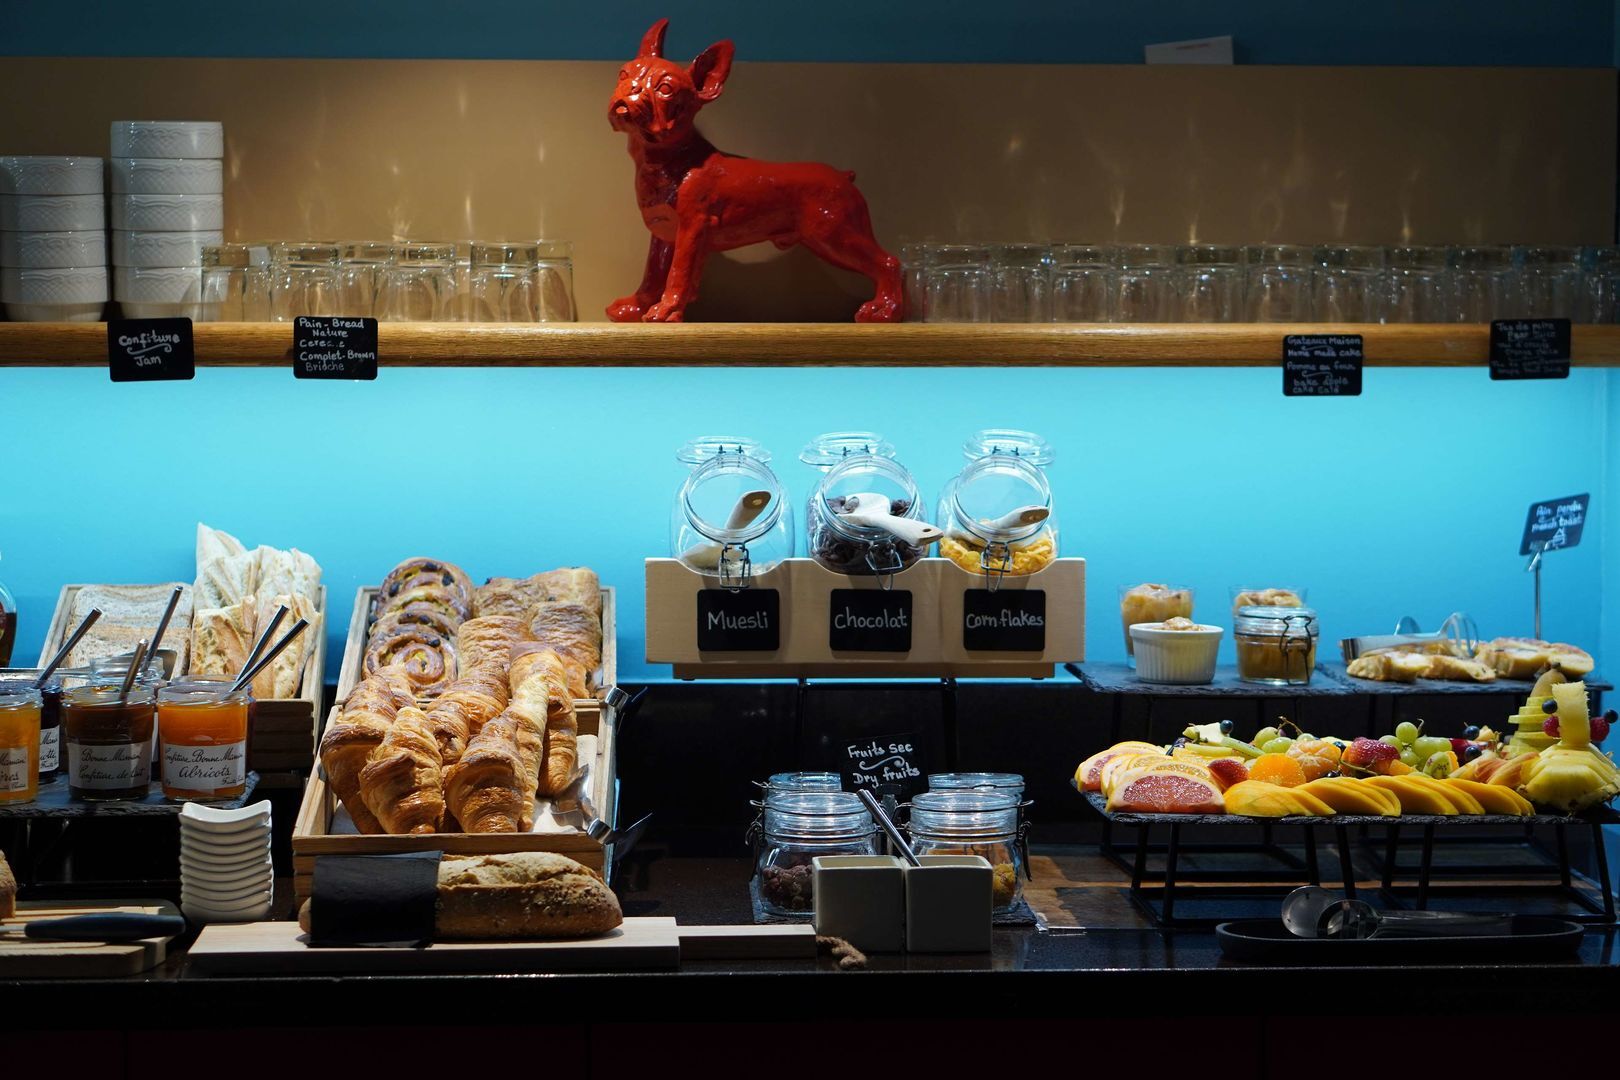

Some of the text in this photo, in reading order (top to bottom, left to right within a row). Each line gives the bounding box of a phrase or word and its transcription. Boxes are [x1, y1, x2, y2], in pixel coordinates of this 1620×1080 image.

[299, 317, 322, 329] Pain
[332, 318, 364, 328] Bread
[118, 329, 181, 348] Confiture
[312, 328, 349, 338] Nature
[133, 355, 161, 367] Jam
[305, 361, 345, 372] Brioche
[707, 609, 768, 630] Muesli
[847, 741, 913, 758] Fruits sec
[852, 762, 920, 789] Dry fruits
